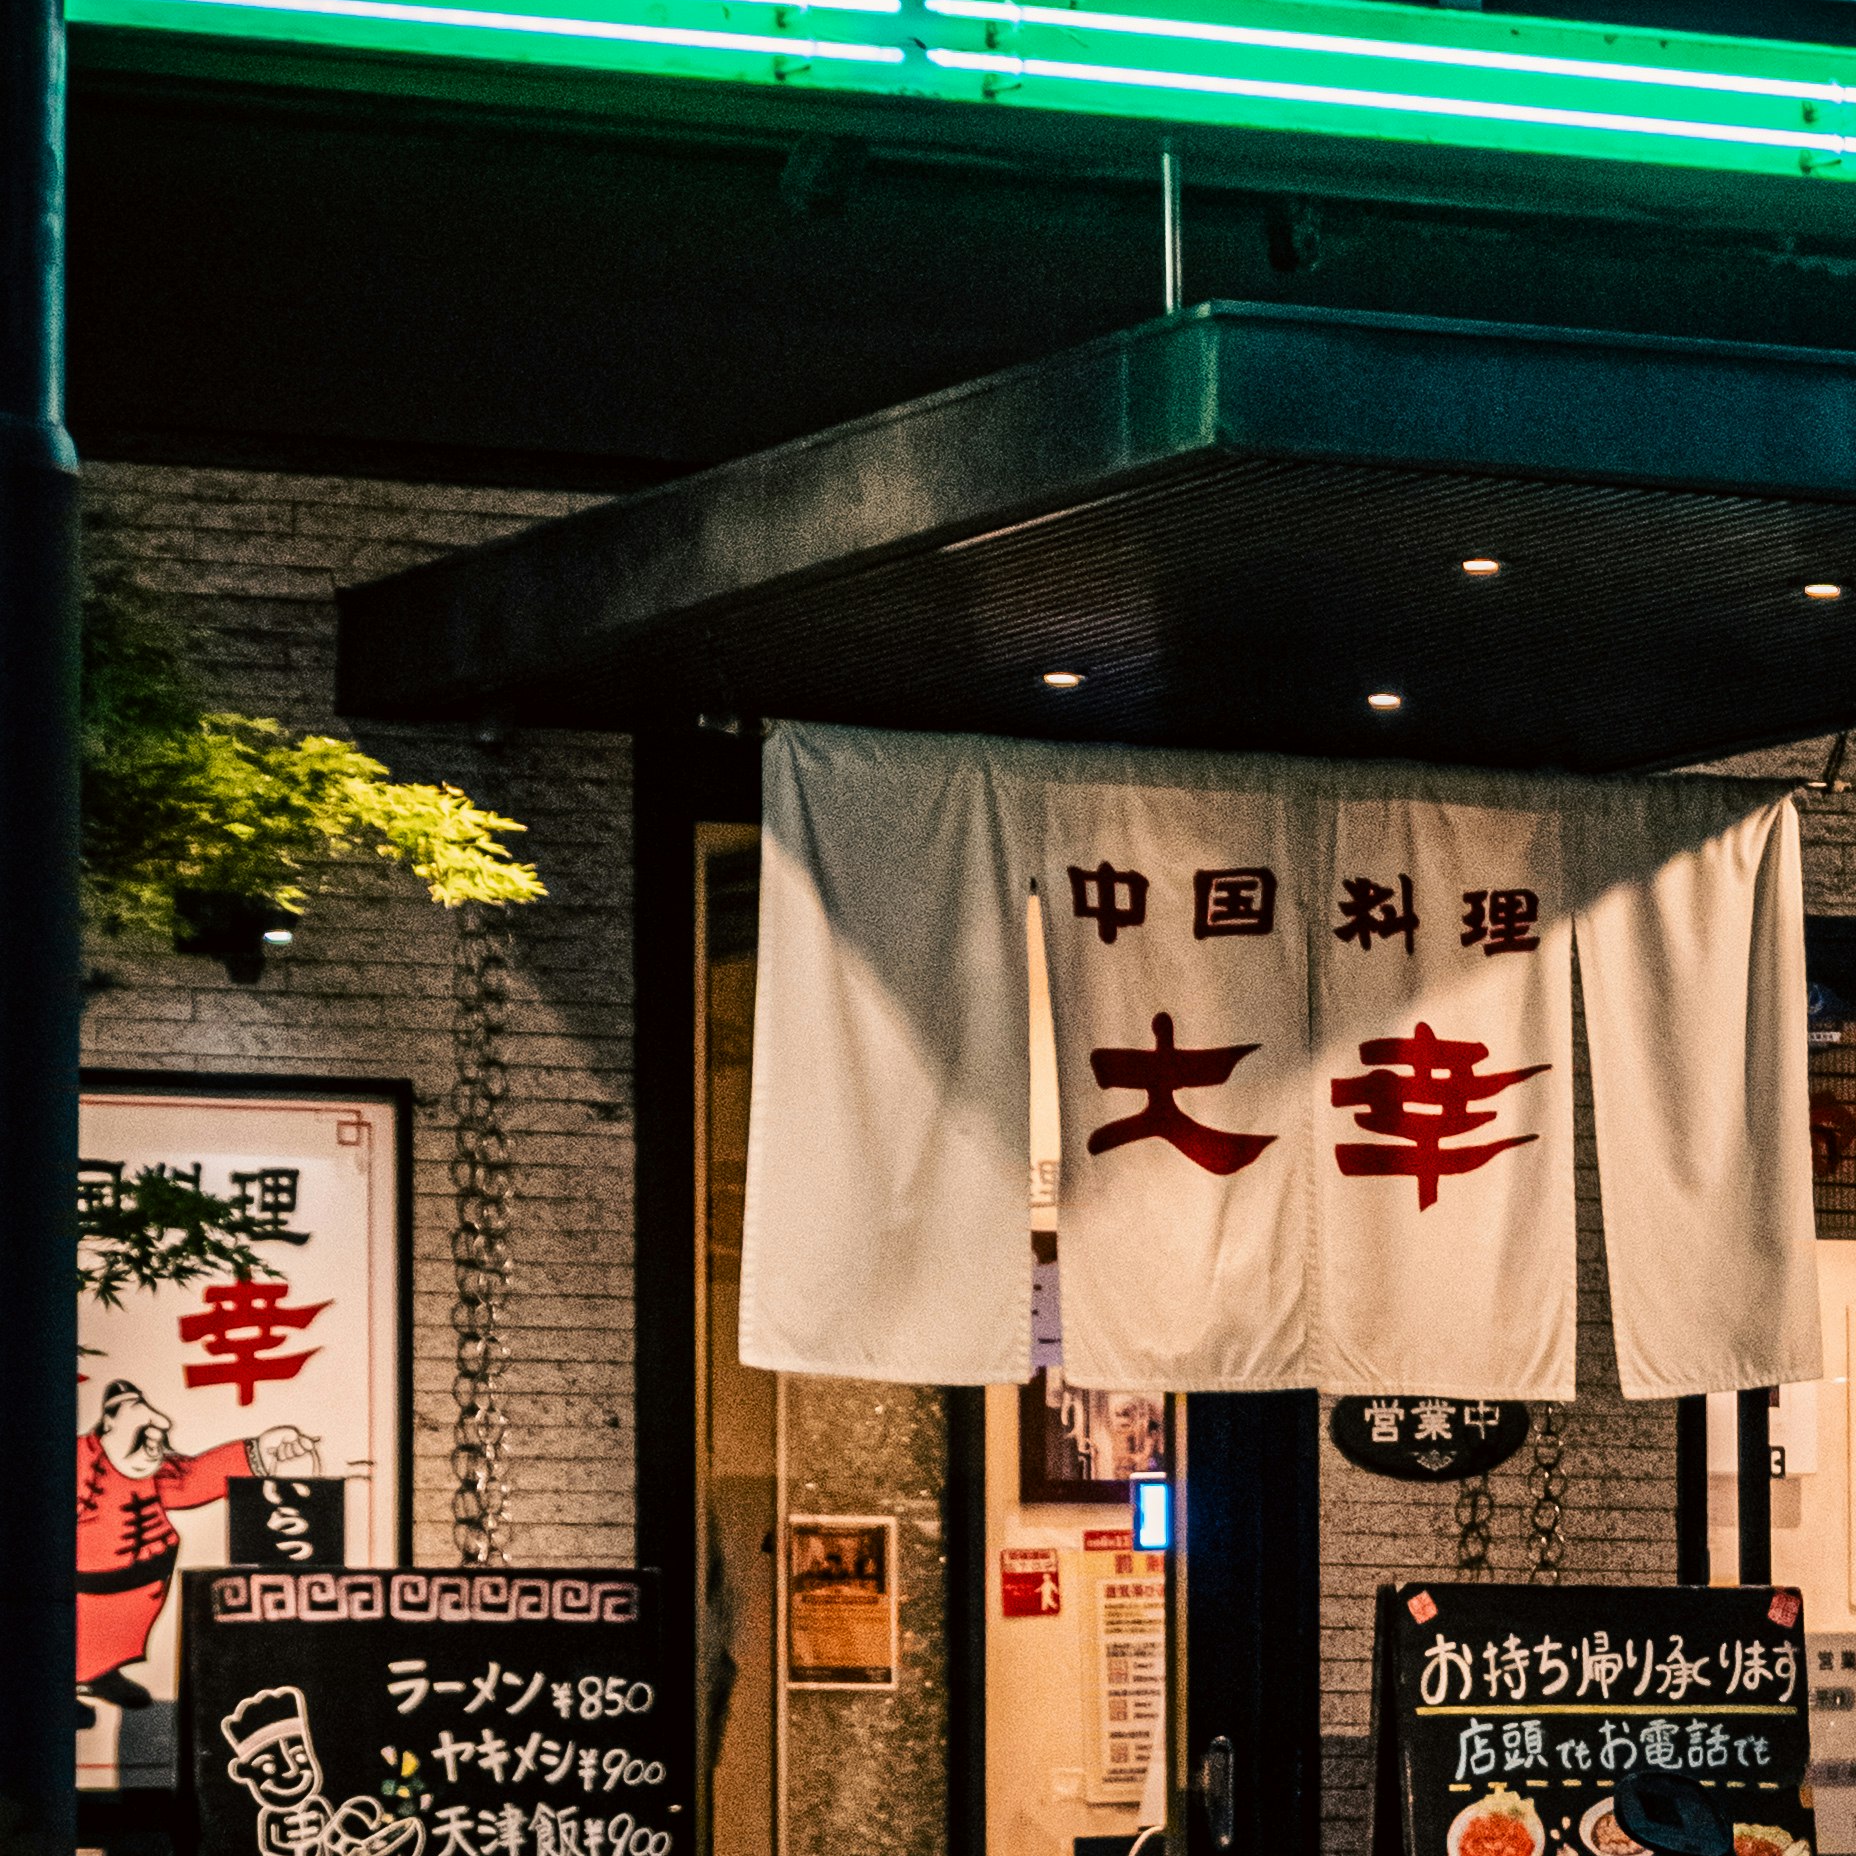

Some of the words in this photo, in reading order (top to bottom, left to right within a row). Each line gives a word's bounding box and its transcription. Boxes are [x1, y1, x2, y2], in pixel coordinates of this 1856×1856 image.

[1067, 861, 1541, 956] 中国料理
[1364, 1398, 1500, 1443] 営業中
[1420, 1631, 1799, 1706] お持ち帰り承ります
[1455, 1718, 1771, 1781] 店頭でもお電話でも
